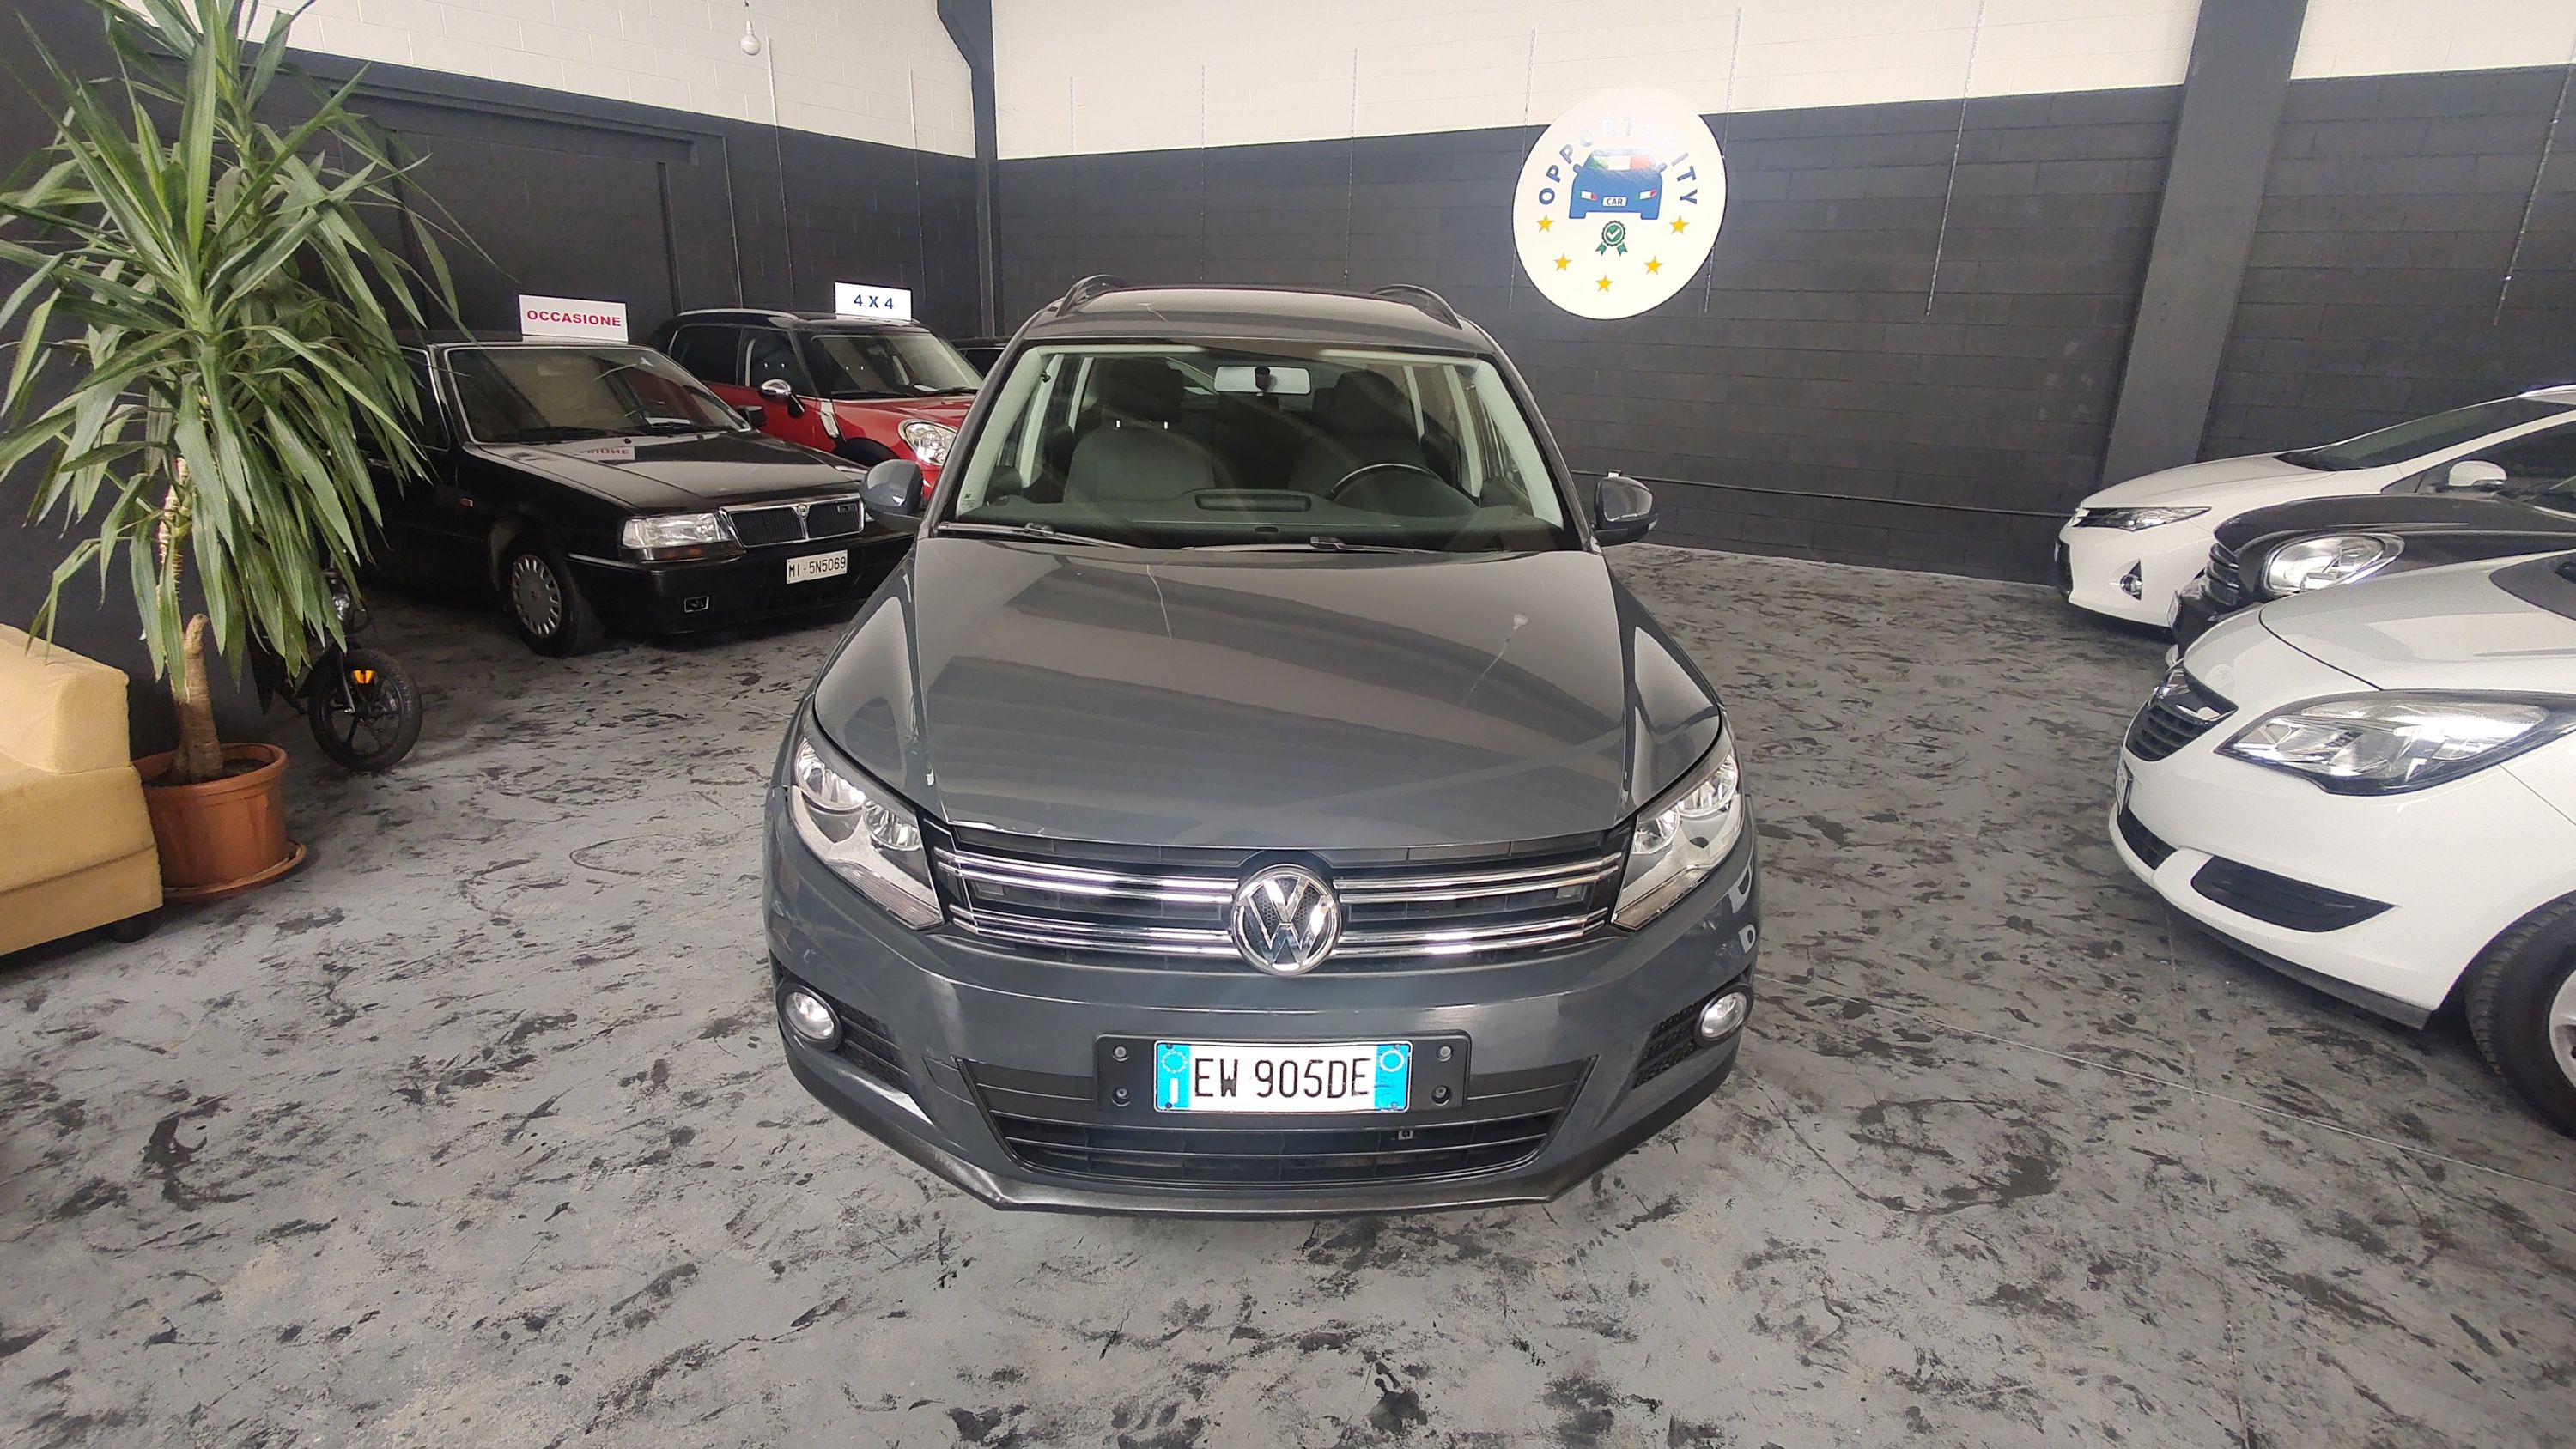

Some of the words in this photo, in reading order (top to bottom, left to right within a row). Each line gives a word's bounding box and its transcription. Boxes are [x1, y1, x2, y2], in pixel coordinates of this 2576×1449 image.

[1606, 197, 1624, 206] CAR
[854, 294, 864, 307] 4
[884, 297, 894, 310] 4
[526, 310, 622, 327] OCCASIONE
[788, 563, 800, 578] MI
[809, 556, 847, 574] 5N5069
[1235, 870, 1338, 970] VW
[1194, 1058, 1239, 1098] EW
[1255, 1058, 1371, 1099] 905DE
